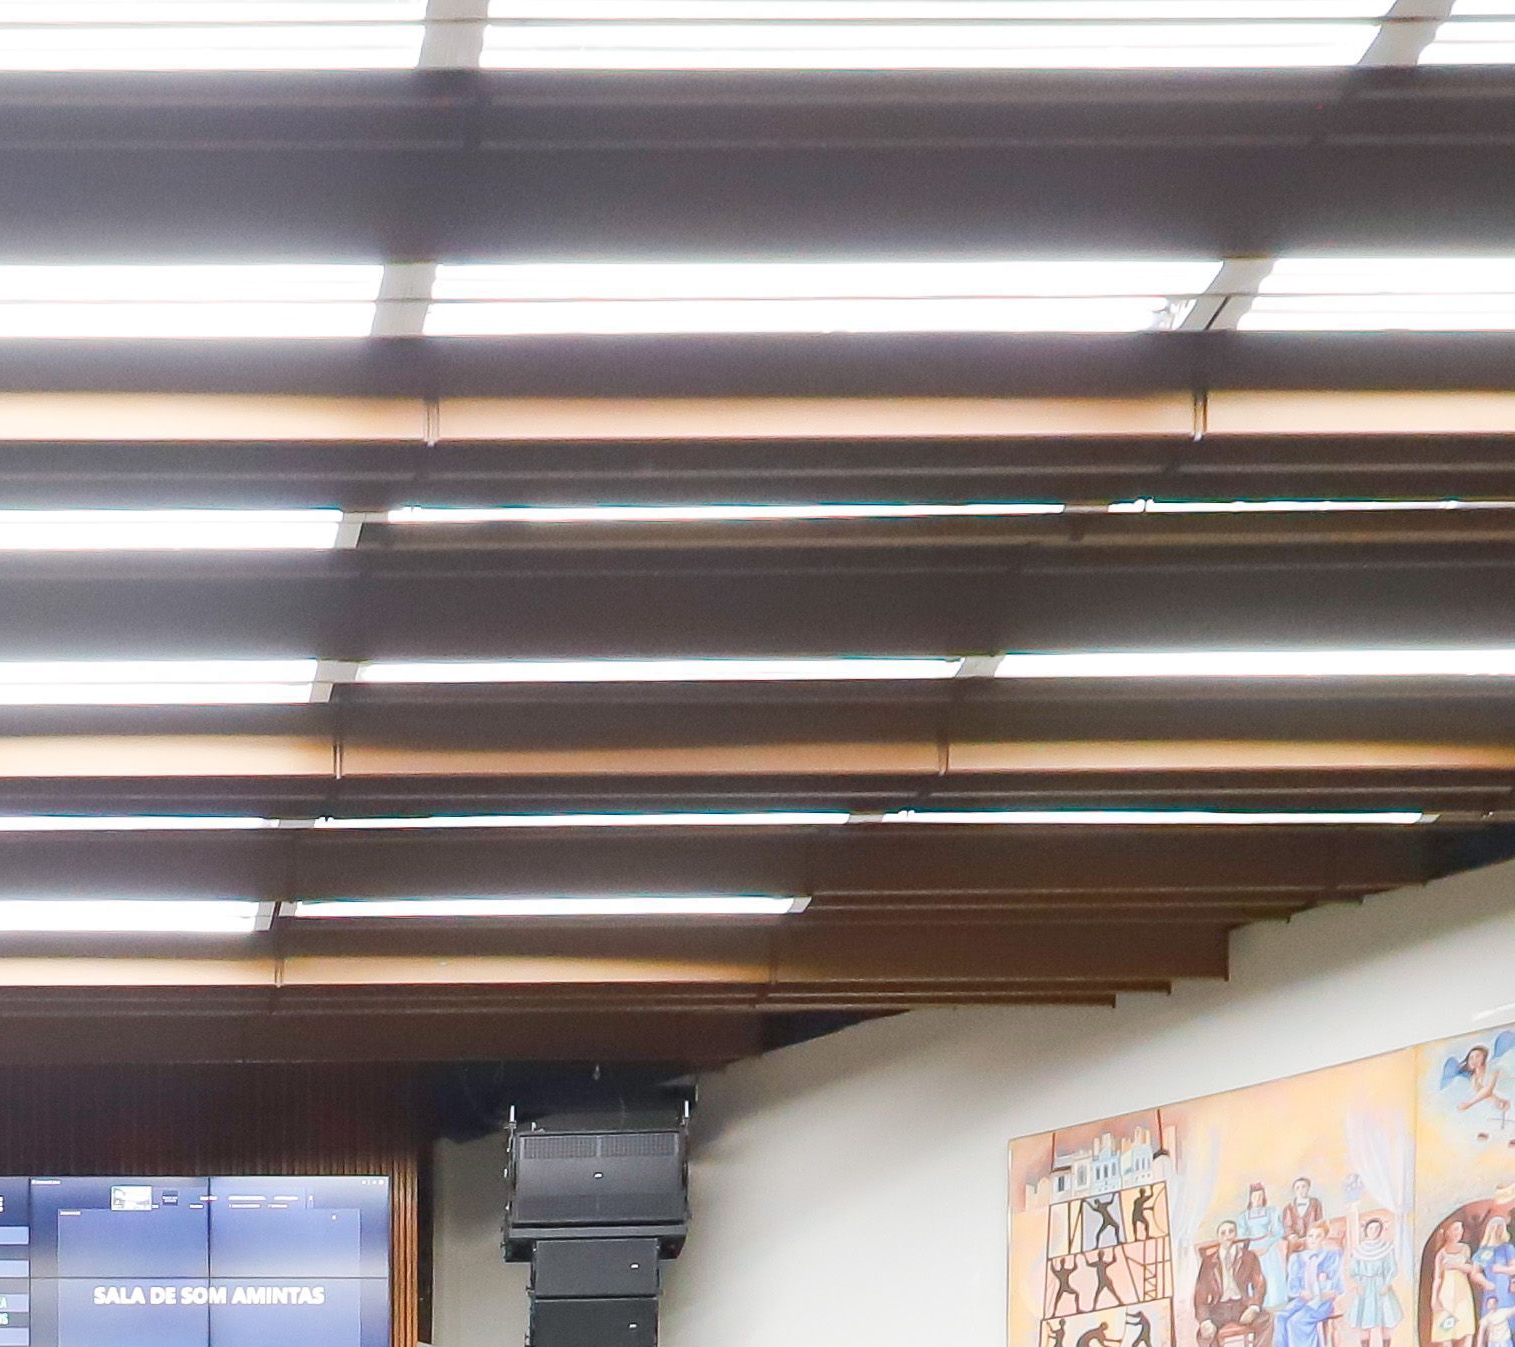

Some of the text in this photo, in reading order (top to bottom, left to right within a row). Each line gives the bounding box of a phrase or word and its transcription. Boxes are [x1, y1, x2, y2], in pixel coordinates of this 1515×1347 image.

[93, 1286, 326, 1305] SALA DE SOM AMINTAS
